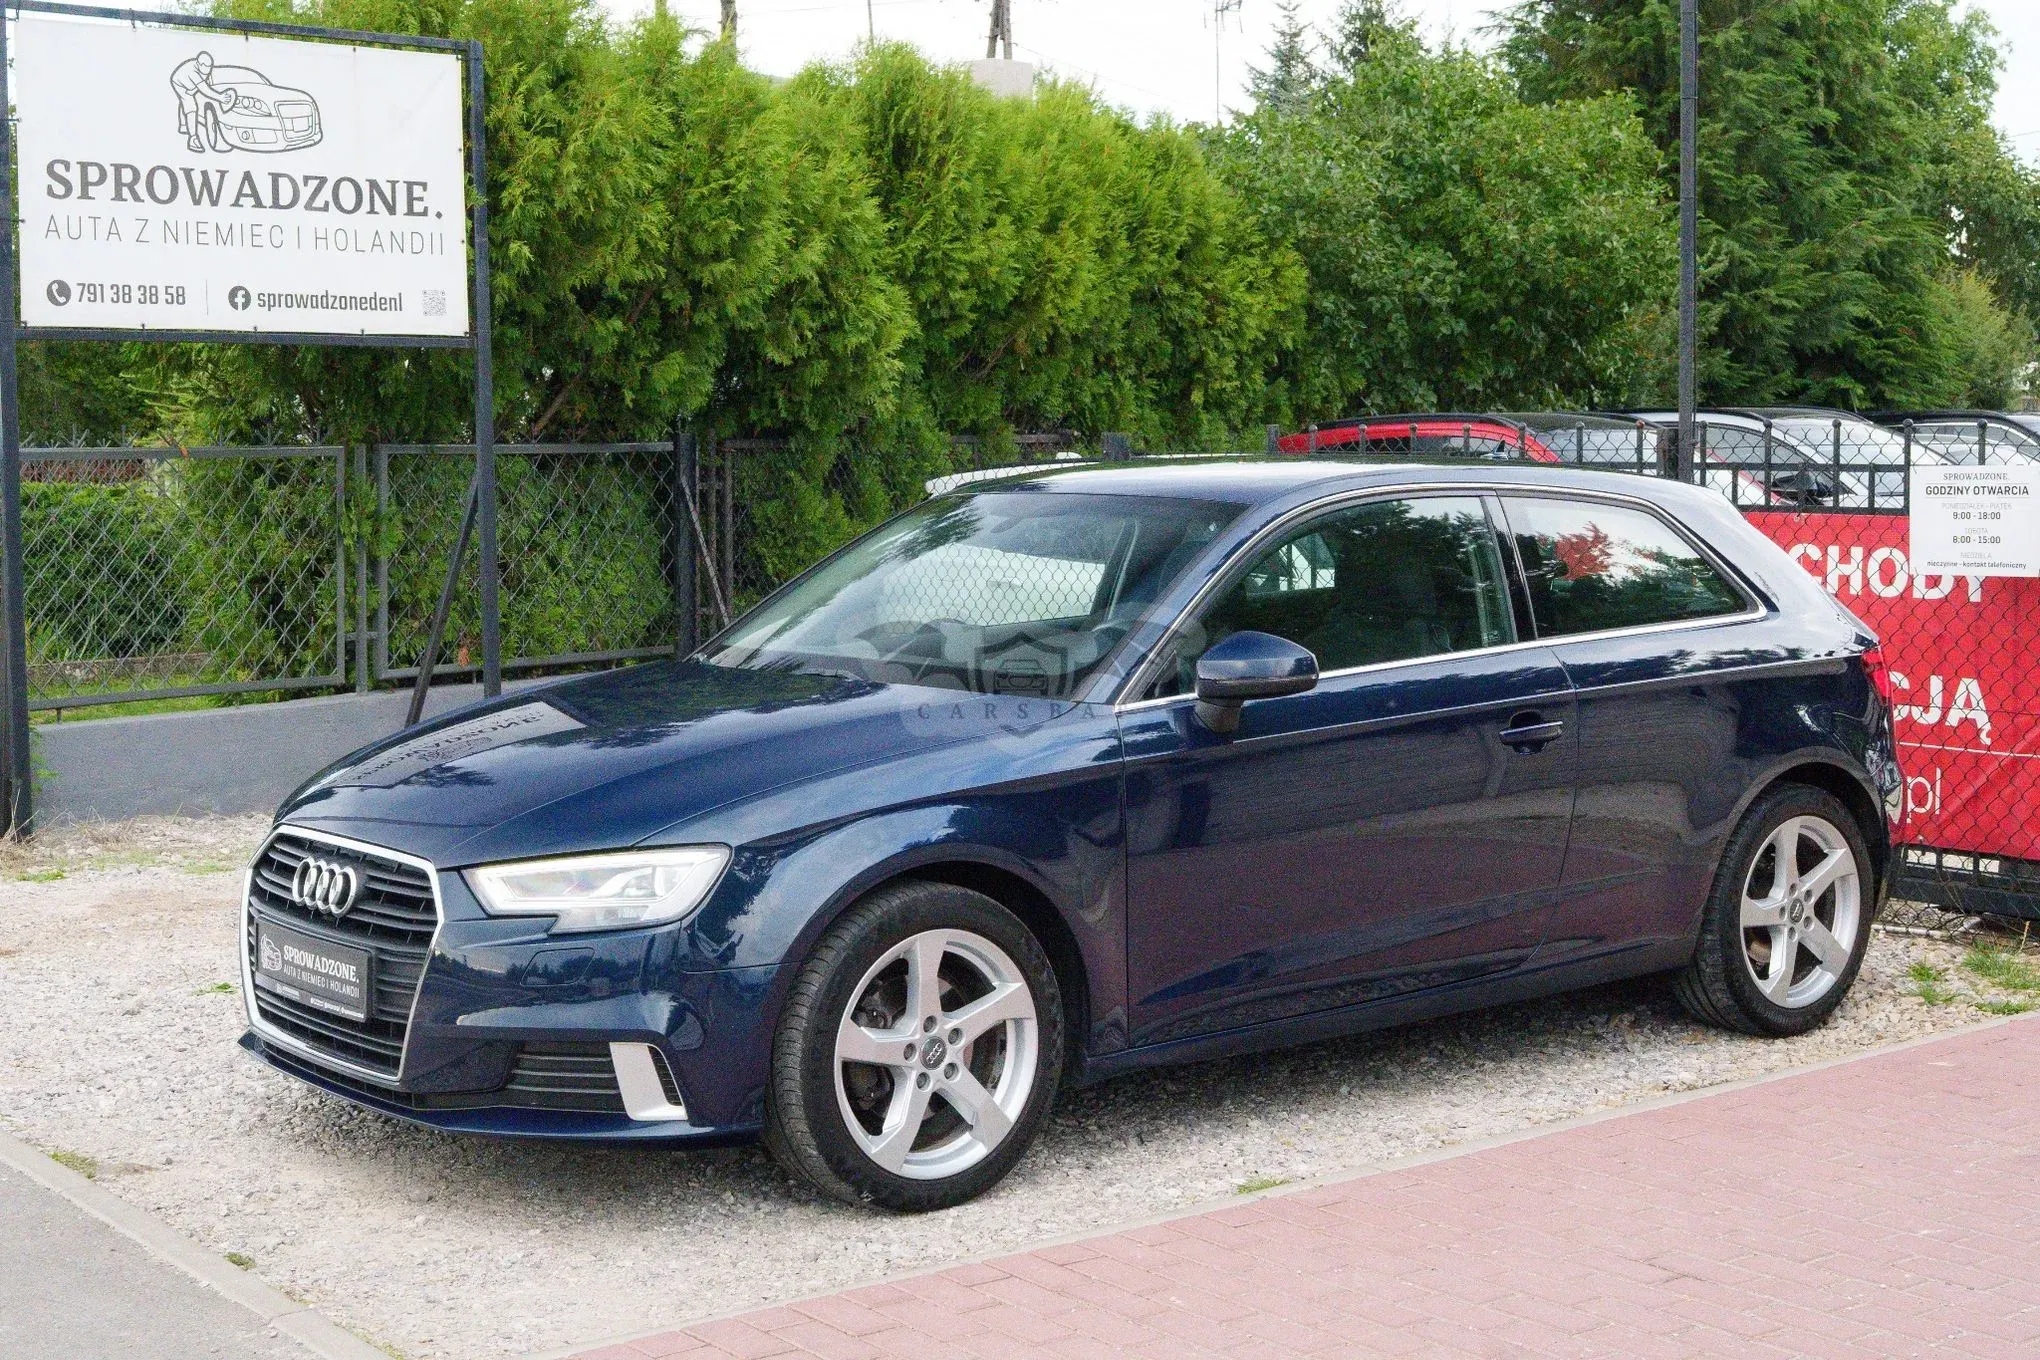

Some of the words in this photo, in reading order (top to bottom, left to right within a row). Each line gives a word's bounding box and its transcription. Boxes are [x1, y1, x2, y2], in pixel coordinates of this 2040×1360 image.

[45, 158, 444, 220] SPROWADZONE.
[45, 213, 122, 242] AUTA
[135, 218, 150, 243] Z
[163, 219, 284, 249] NIEMIEC
[297, 225, 301, 249] I
[314, 226, 444, 255] HOLANDII
[76, 283, 105, 303] 791
[110, 284, 132, 304] 38
[138, 285, 159, 305] 38
[165, 286, 186, 306] 58
[257, 290, 403, 312] sprowadzonedenl
[1925, 485, 1970, 496] GODZINY
[1973, 485, 2029, 496] OTWARCIA
[1952, 511, 1971, 520] 9:00
[1978, 511, 2001, 520] 18:00
[1952, 535, 1971, 544] 8:00
[1978, 535, 2001, 544] 15:00
[1963, 560, 1987, 568] kontakt
[1988, 561, 2027, 570] telefoniczny
[283, 944, 360, 984] SPROWADZONE.
[283, 964, 296, 979] AUTA
[297, 971, 301, 980] Z
[302, 971, 326, 988] NIEMIEC
[330, 980, 360, 999] HOLANDII
